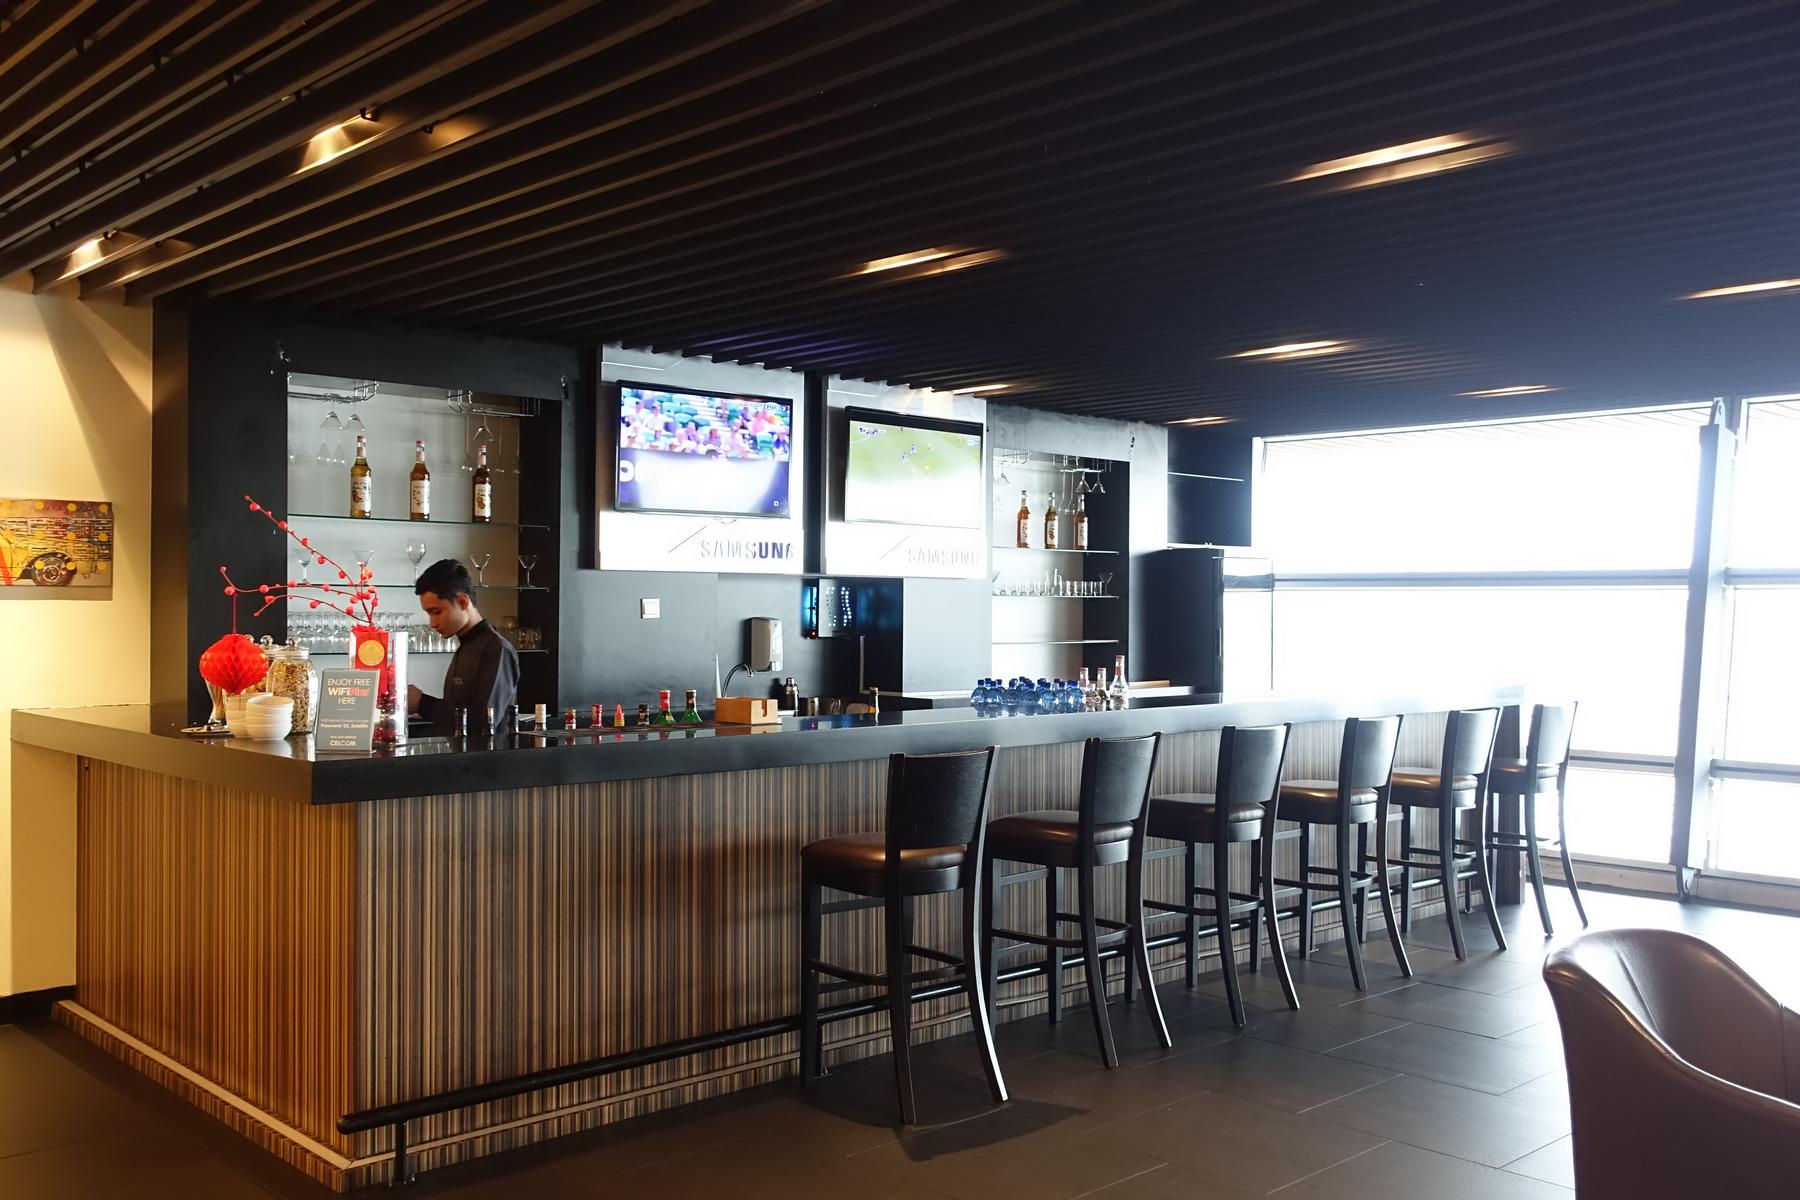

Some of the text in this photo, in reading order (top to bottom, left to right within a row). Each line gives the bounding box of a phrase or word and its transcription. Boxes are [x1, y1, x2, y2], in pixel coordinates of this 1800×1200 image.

[701, 540, 794, 559] SAMSUNG
[327, 678, 371, 686] ENJOY FREE
[337, 697, 357, 705] HERE
